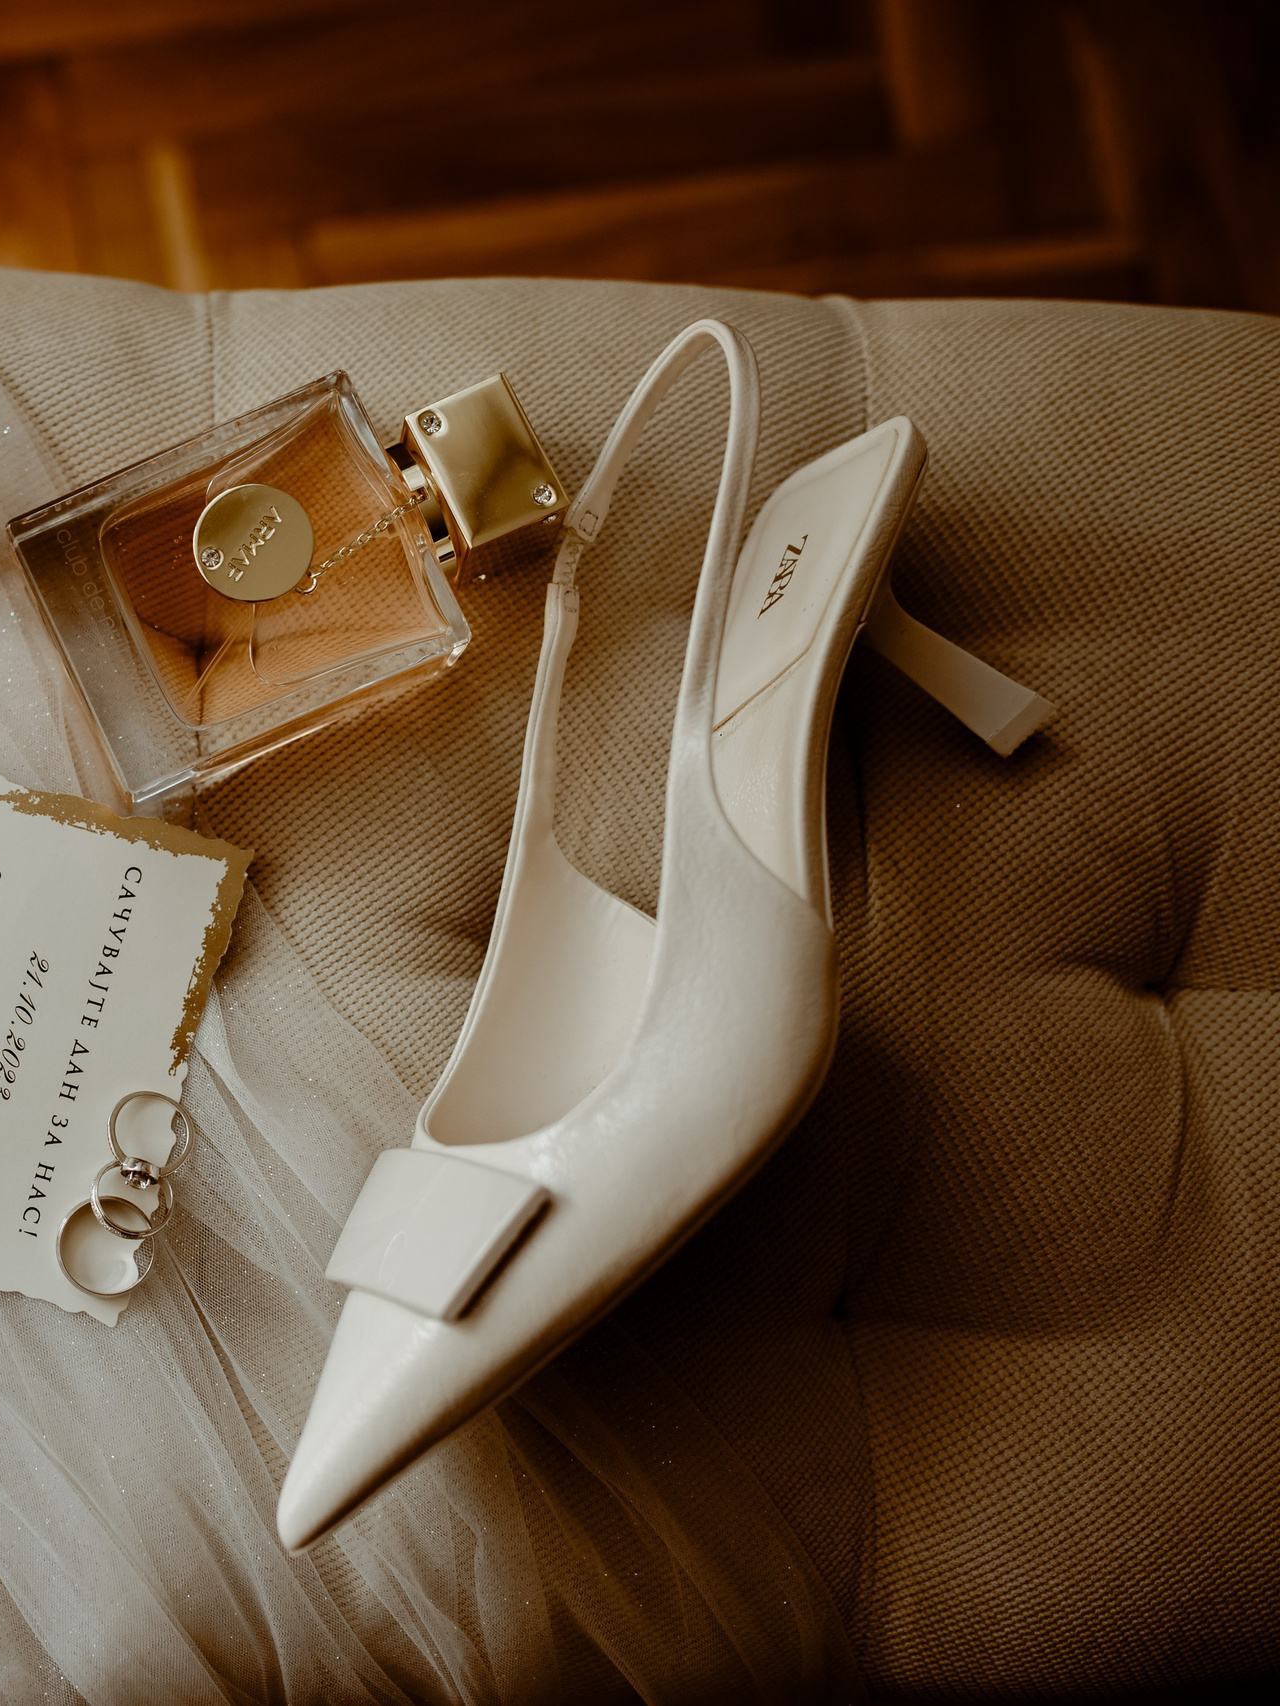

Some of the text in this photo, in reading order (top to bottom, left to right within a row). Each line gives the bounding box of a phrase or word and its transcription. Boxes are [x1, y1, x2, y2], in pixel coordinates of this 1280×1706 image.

[56, 528, 88, 576] club
[82, 581, 106, 612] de
[227, 505, 282, 582] ARMAF
[757, 534, 809, 620] ZARA
[18, 866, 143, 1238] САЧУВАЈТЕ ДАН ЗА НАС!
